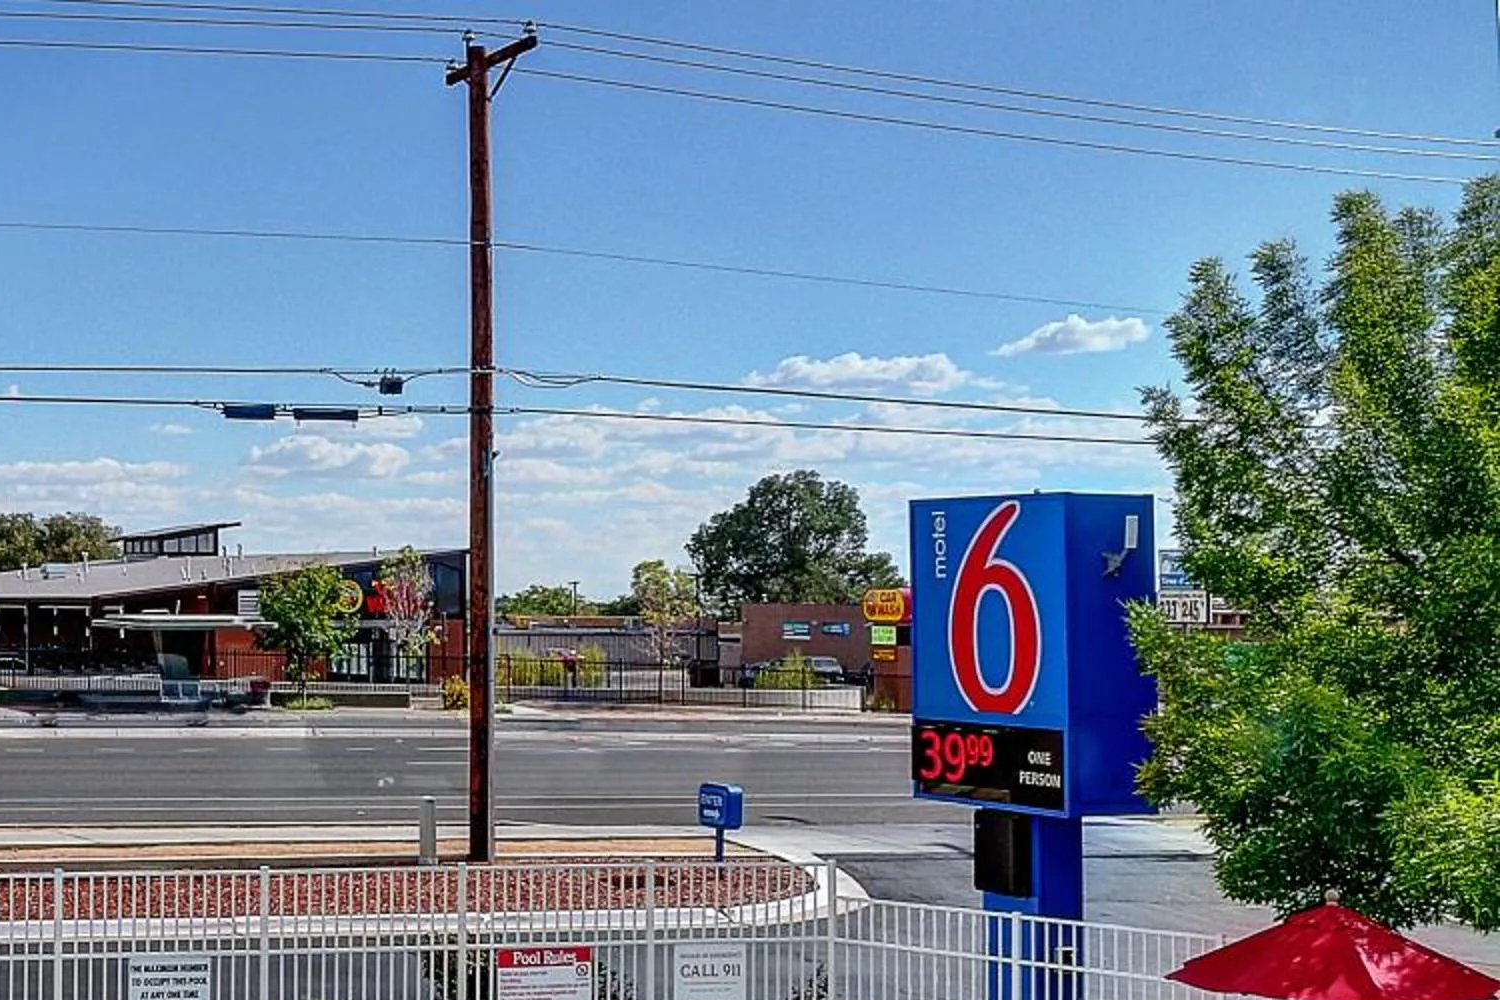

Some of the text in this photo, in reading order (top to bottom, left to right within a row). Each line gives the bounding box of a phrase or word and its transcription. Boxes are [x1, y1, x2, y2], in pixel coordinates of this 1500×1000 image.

[931, 511, 946, 579] motel
[947, 499, 1042, 715] 6
[1028, 750, 1052, 767] ONE
[1019, 770, 1062, 789] PERSON
[513, 950, 577, 965] Pool Rules
[680, 963, 741, 977] CALL 911
